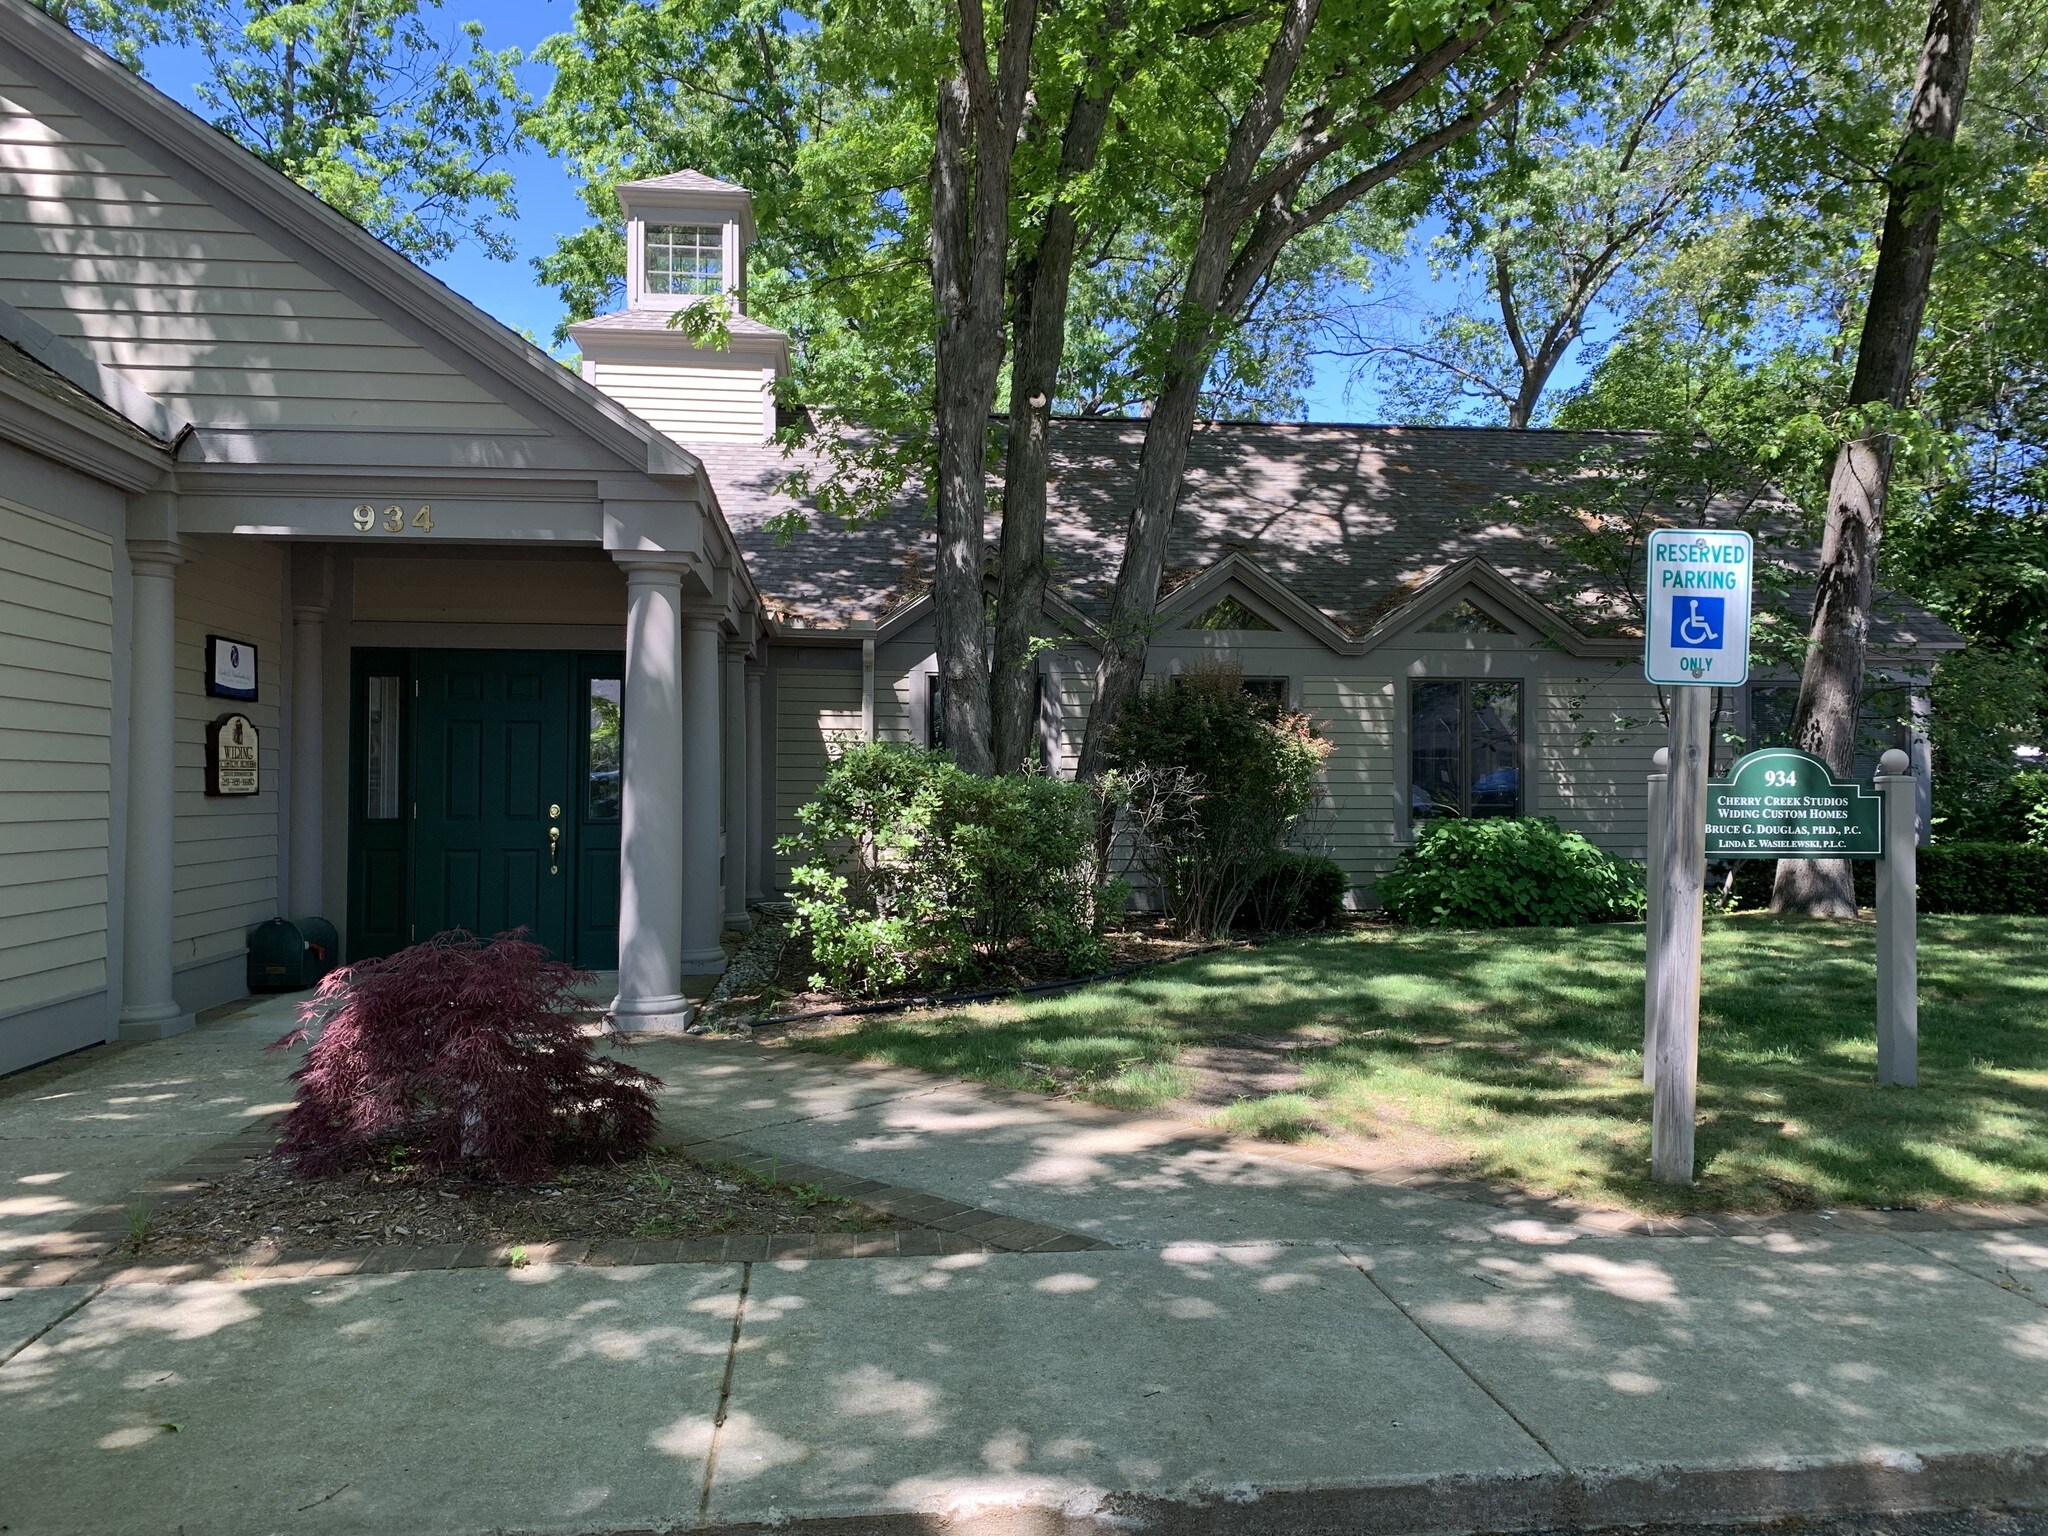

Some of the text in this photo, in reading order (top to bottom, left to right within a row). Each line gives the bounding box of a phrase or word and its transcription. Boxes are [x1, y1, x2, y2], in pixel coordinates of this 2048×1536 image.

[353, 504, 434, 533] 934
[1656, 543, 1745, 564] RESERVED
[1662, 569, 1736, 590] PARKING
[1680, 657, 1713, 672] ONLY
[223, 745, 254, 760] WIDING
[1764, 770, 1797, 787] 934
[1717, 795, 1849, 807] CHERRY CREEK STUDIOS
[1717, 808, 1848, 819] WIDING CUSTOM HOMES
[1704, 824, 1862, 836] BRUCE G. DOUGLAS, PH.D., P.C.
[1718, 839, 1847, 849] LINDA E. WASIELEWSKI, P.L.C.
